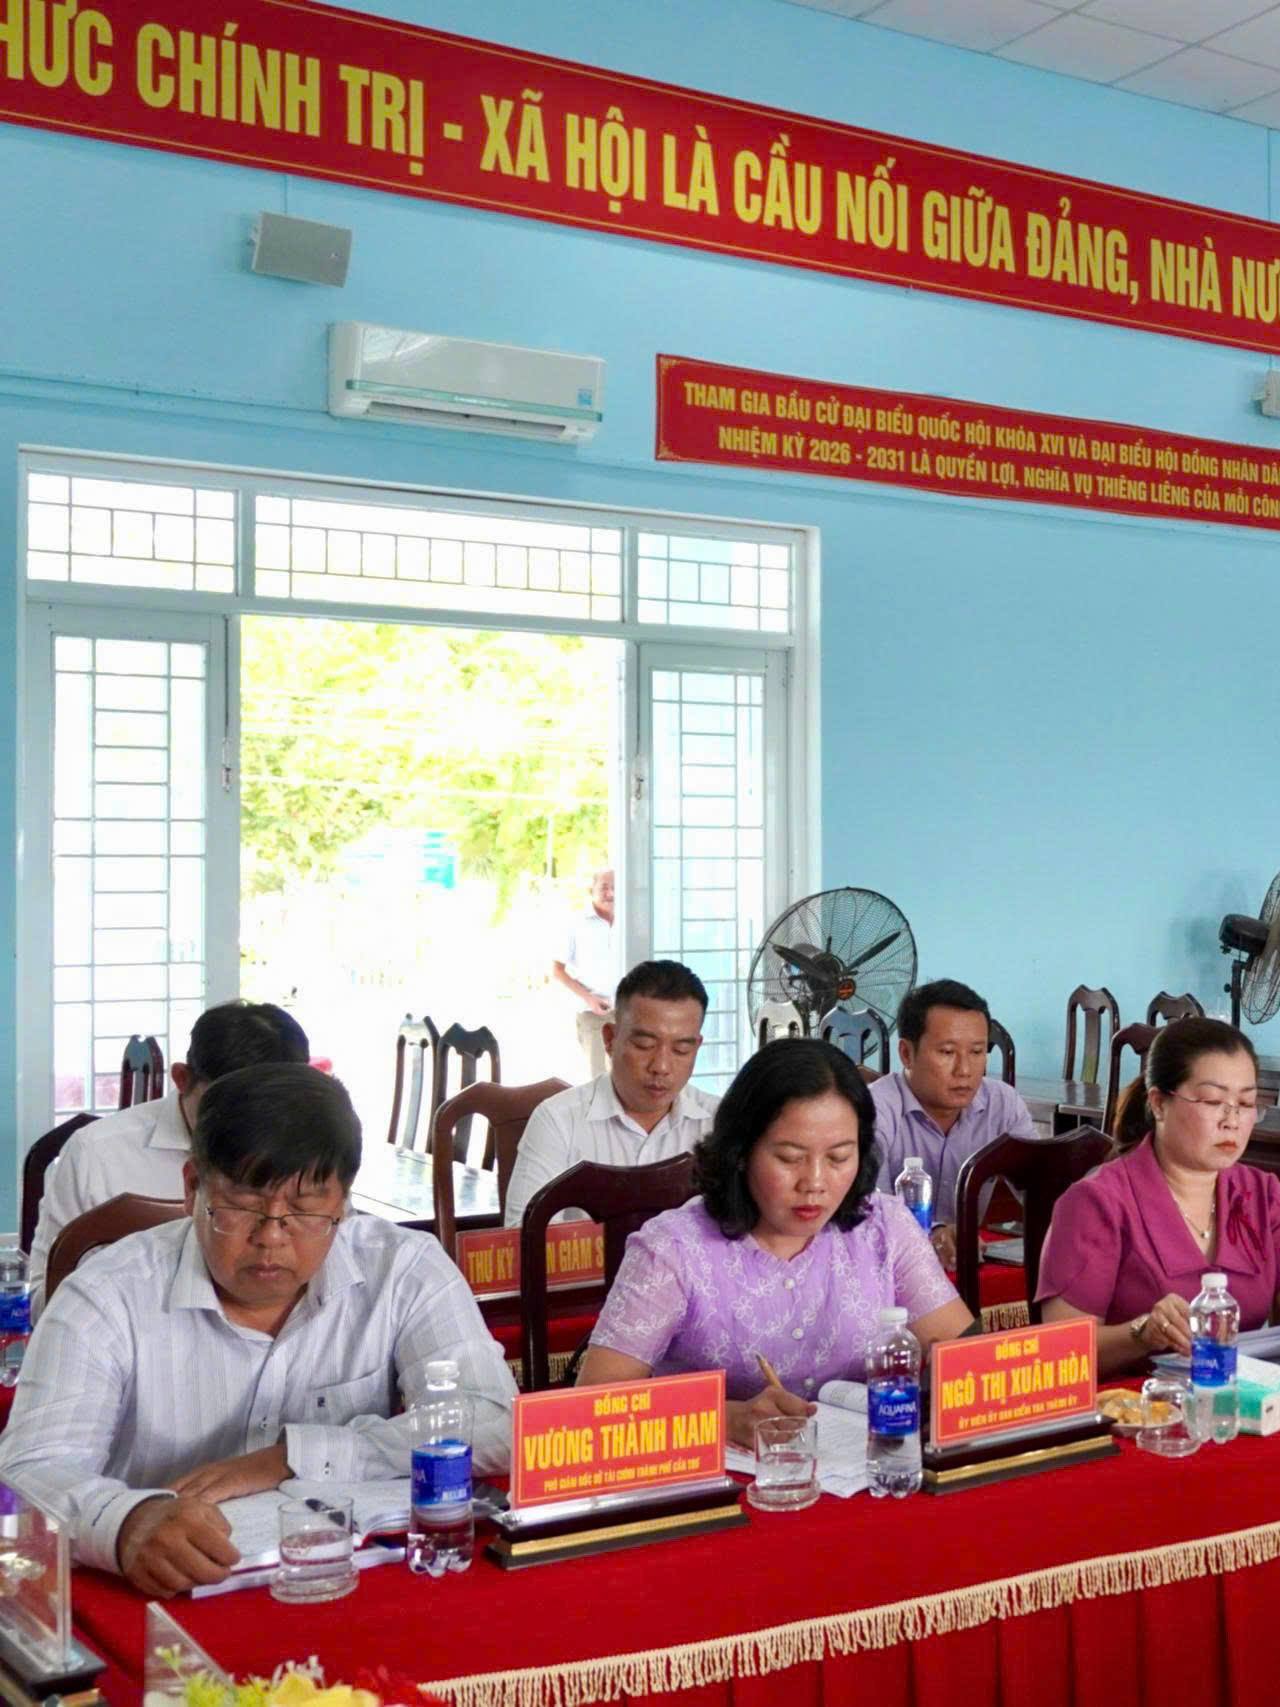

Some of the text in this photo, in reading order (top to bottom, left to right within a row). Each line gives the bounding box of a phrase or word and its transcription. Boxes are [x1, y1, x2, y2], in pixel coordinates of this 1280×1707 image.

[137, 22, 321, 136] CHÍNH
[339, 64, 426, 176] TRỊ
[443, 122, 464, 141] -
[480, 88, 551, 183] XÃ
[565, 106, 648, 214] HỘI
[662, 124, 719, 217] LÀ
[733, 133, 822, 238] CẦU
[836, 157, 909, 252] NỐI
[922, 186, 1016, 273] GIỮA
[1026, 197, 1140, 306] ĐẢNG,
[1150, 237, 1223, 313] NHÀ
[683, 381, 736, 412] THAM
[740, 389, 771, 416] GIA
[775, 389, 811, 422] BẦU
[816, 395, 841, 426] CỬ
[843, 404, 872, 434] ĐẠI
[875, 403, 914, 436] BIỂU
[918, 411, 961, 443] QUỐC
[965, 419, 991, 450] HỘI
[995, 425, 1037, 453] KHÓA
[1040, 432, 1065, 456] XVI
[1068, 433, 1088, 460] VÀ
[1091, 440, 1115, 467] ĐẠI
[1119, 438, 1152, 468] BIỂU
[1155, 447, 1178, 475] HỘI
[1222, 457, 1258, 484] NHÂN
[719, 426, 778, 459] NHIỆM
[782, 431, 805, 459] KỲ
[809, 439, 851, 466] 2026
[867, 446, 905, 472] 2031
[911, 450, 932, 475] LÀ
[1024, 467, 1070, 493] NGHĨA
[1073, 473, 1093, 499] VỤ
[1096, 475, 1147, 503] THIÊNG
[1151, 480, 1190, 507] LIÊNG
[1194, 483, 1221, 511] CỦA
[467, 1243, 495, 1284] THƯ
[497, 1240, 514, 1280] KÝ
[559, 1232, 592, 1272] GIÁM
[942, 1371, 976, 1410] NGÔ
[981, 1371, 1007, 1405] THỊ
[1011, 1358, 1055, 1397] XUÂN
[524, 1409, 718, 1471] VƯƠNG THÀNH NAM
